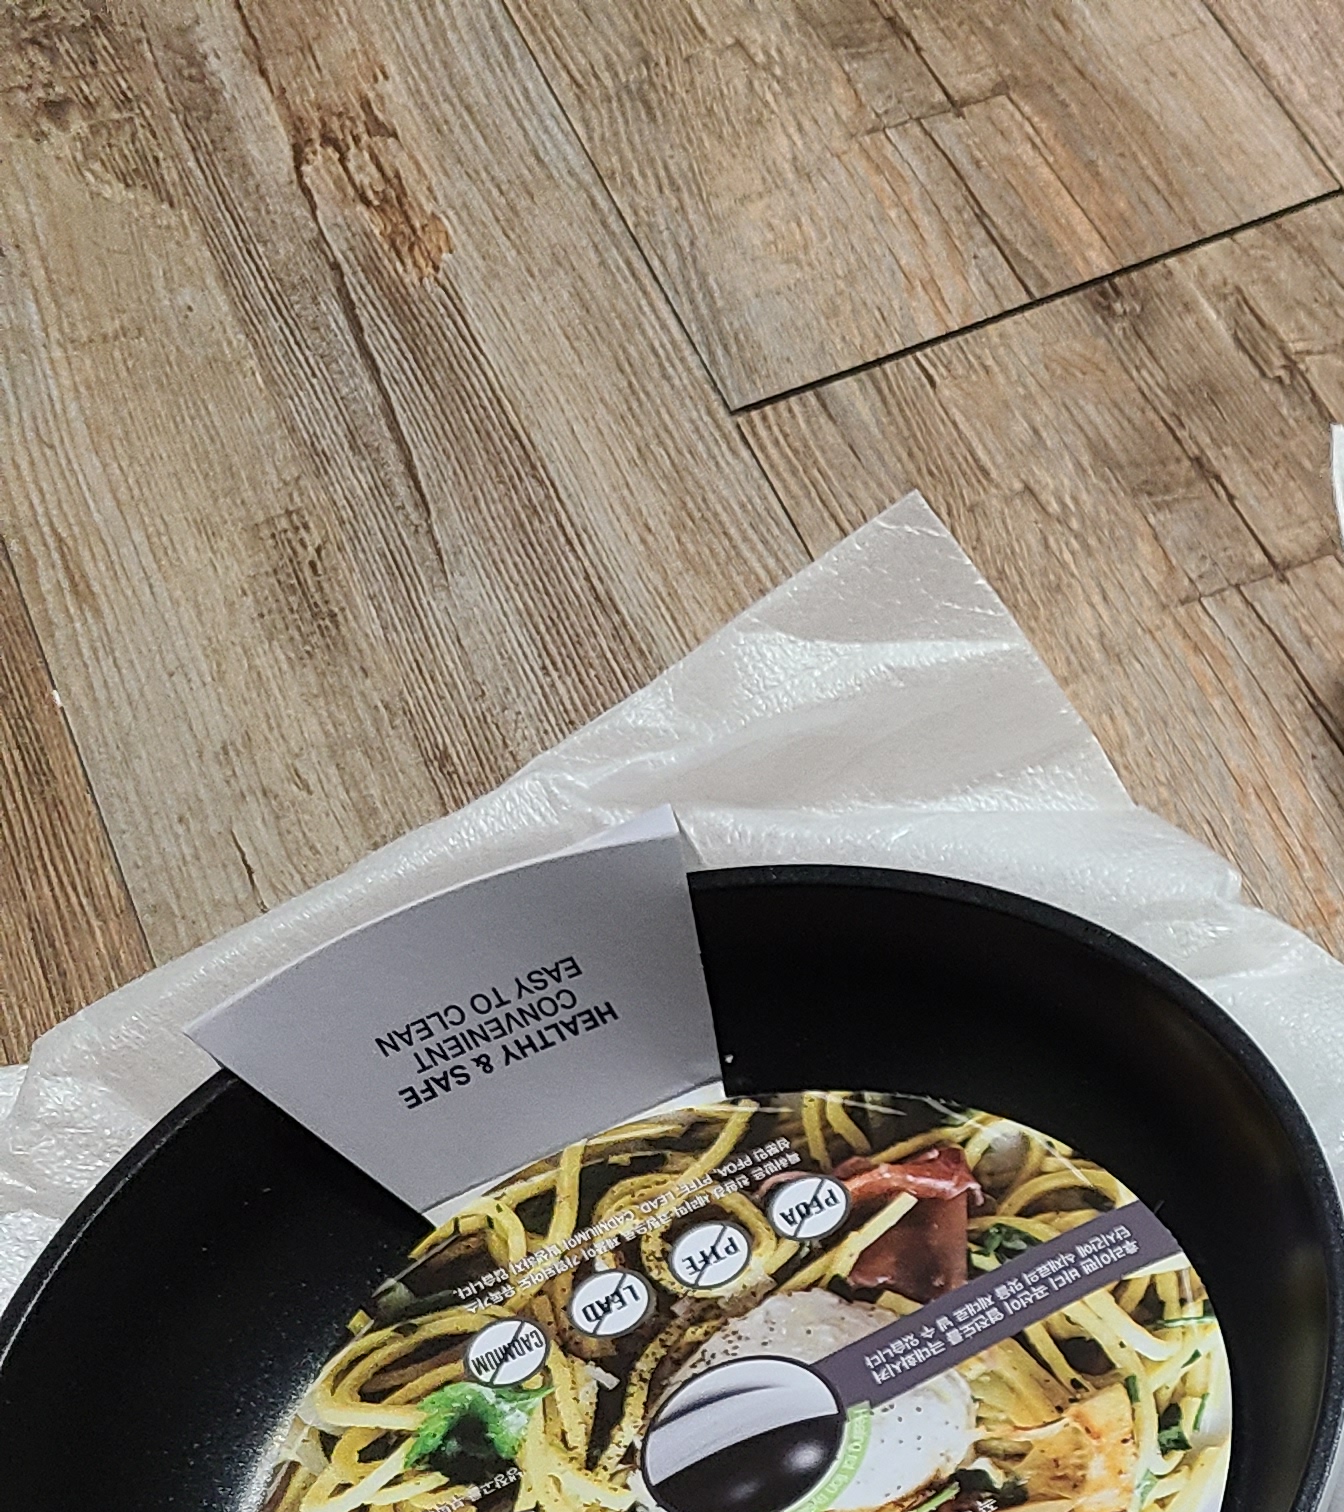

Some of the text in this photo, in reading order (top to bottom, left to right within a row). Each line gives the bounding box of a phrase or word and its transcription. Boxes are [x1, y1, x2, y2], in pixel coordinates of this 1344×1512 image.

[373, 952, 582, 1060] EASY TO CLEAN
[408, 984, 579, 1075] CONVENIENT
[396, 998, 619, 1111] HEALTHY & SAFE
[777, 1186, 841, 1230] PFOA
[679, 1234, 740, 1277] PTFE
[579, 1282, 640, 1325] LEAD
[870, 1234, 1140, 1385] 후라이팬 바디 곡선이 열전도를 극대화시켜
[469, 1327, 544, 1377] CADMIUM
